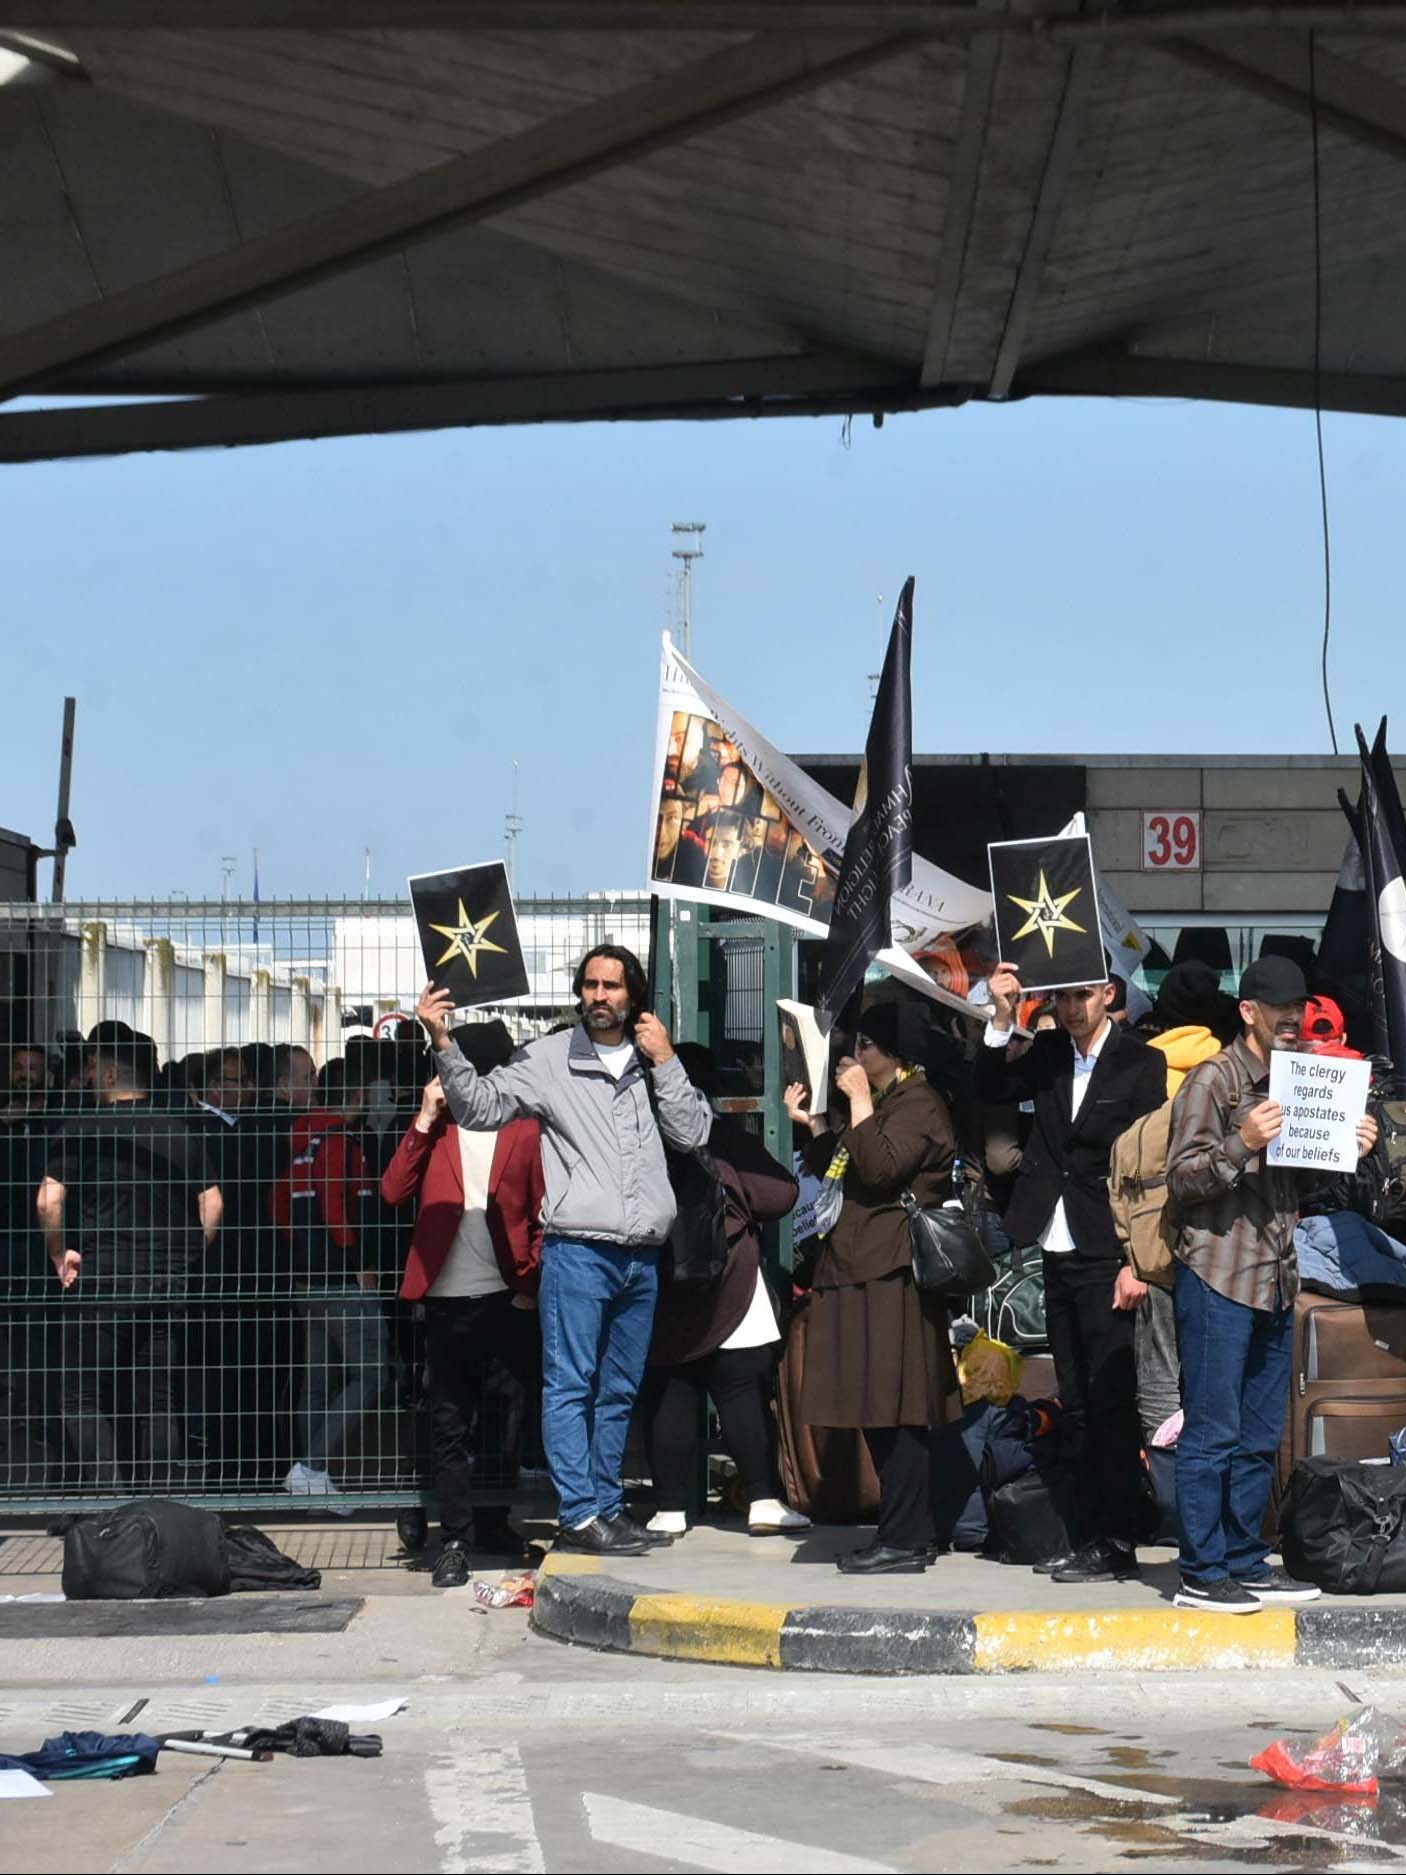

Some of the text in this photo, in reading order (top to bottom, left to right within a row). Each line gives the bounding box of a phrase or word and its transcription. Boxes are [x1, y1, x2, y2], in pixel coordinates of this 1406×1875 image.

[807, 813, 844, 850] Fron
[1149, 816, 1196, 865] 39
[1290, 1060, 1346, 1083] The clergy
[1293, 1085, 1334, 1100] regards
[1293, 1104, 1346, 1122] apostates
[1288, 1123, 1330, 1141] because
[1276, 1144, 1341, 1163] of our beliefs
